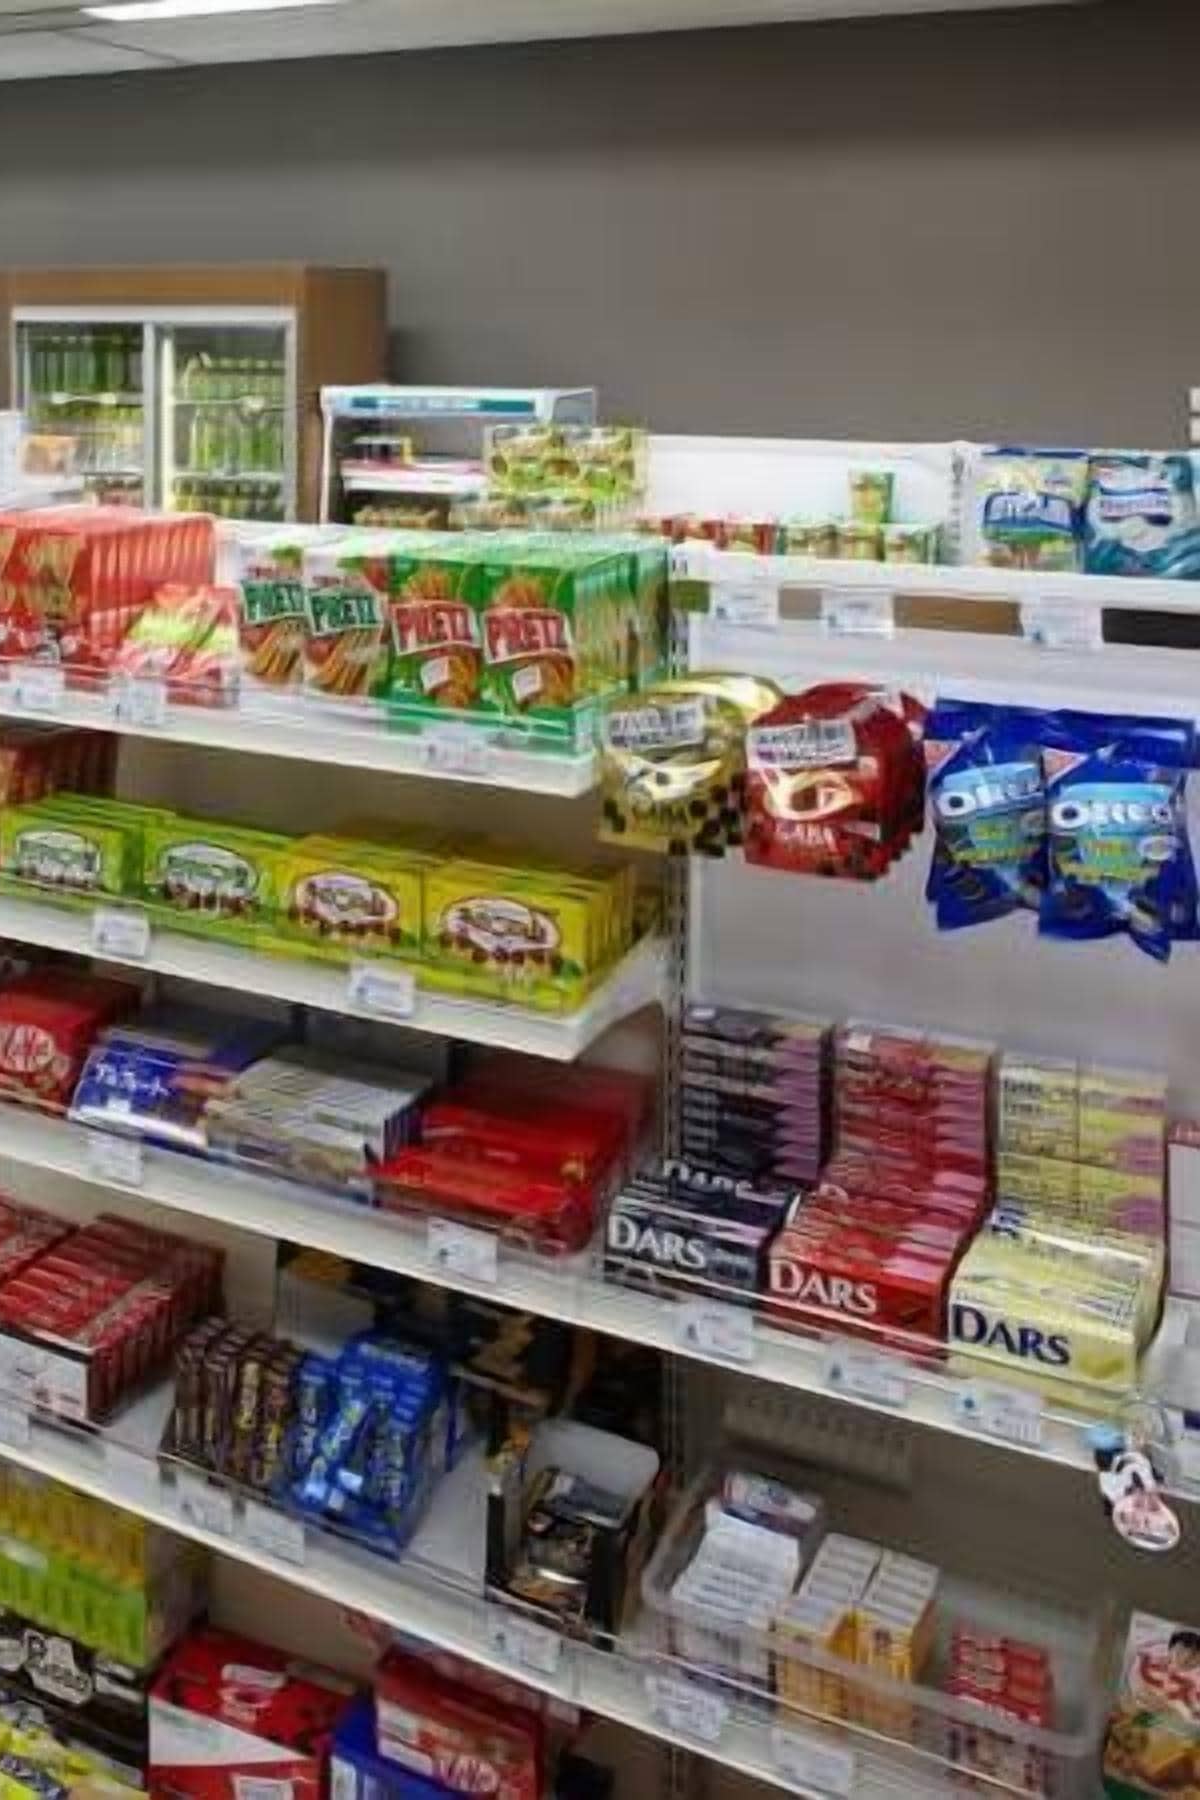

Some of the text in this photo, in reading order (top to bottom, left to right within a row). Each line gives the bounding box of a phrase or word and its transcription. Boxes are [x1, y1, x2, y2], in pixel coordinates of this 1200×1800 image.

[608, 1214, 706, 1269] DARS
[770, 1258, 878, 1314] DARS
[952, 1303, 1071, 1365] DARS
